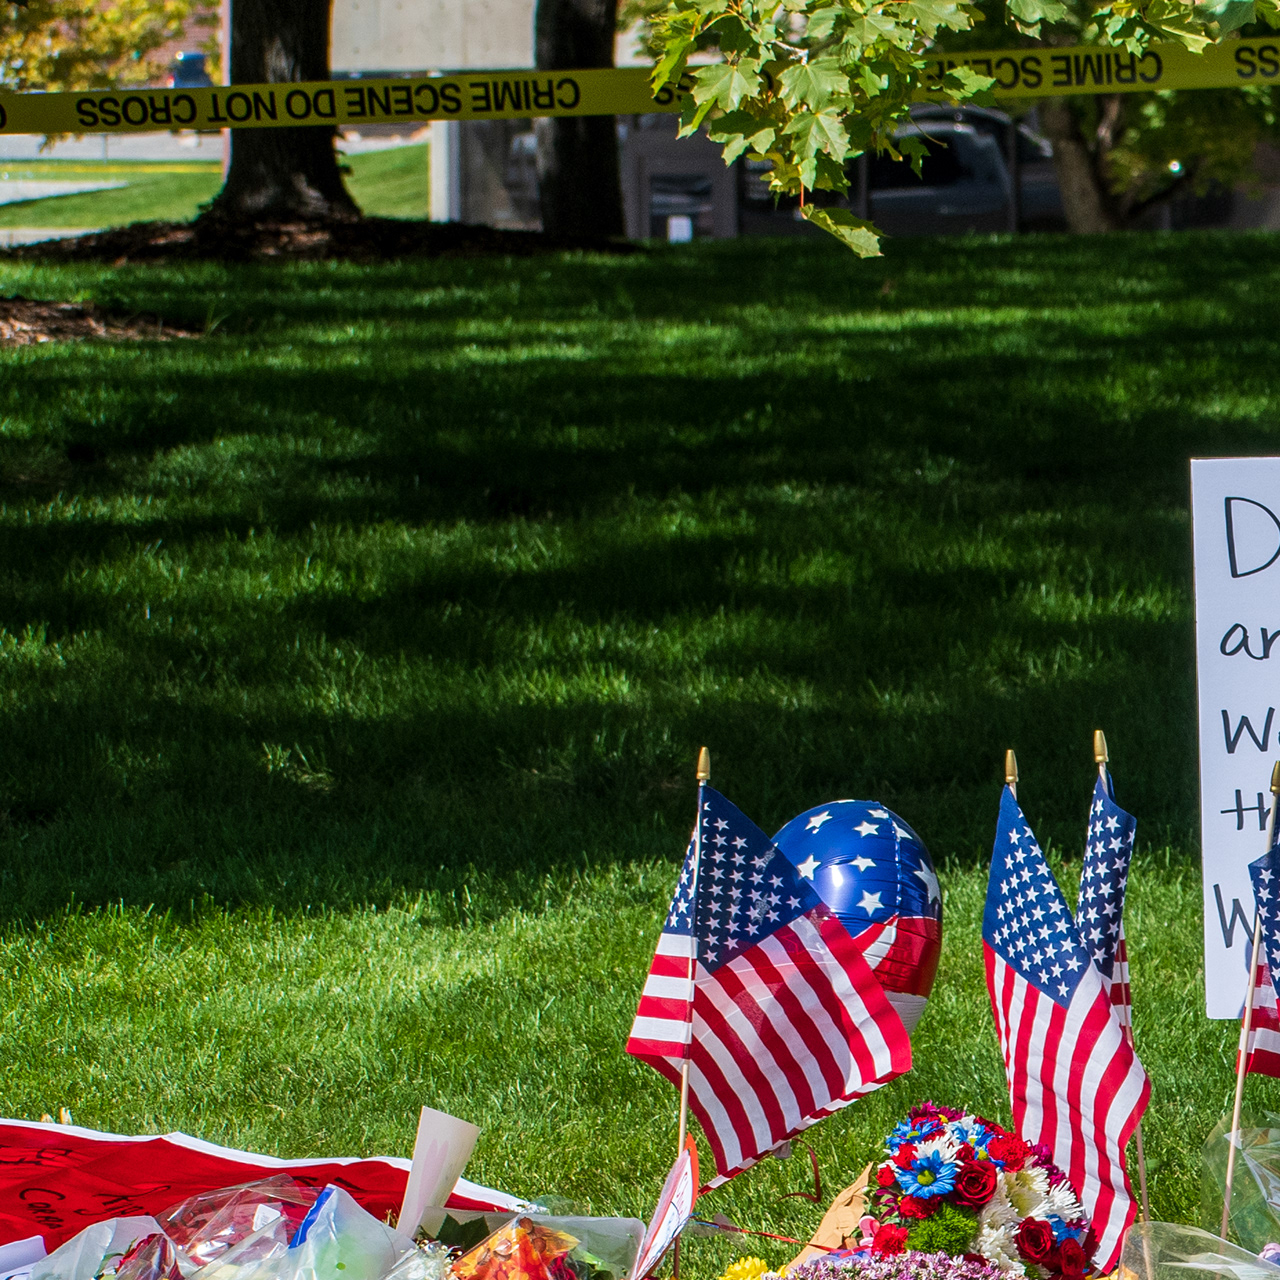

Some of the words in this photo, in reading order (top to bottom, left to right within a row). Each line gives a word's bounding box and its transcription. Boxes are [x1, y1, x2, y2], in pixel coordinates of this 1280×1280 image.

[1051, 51, 1163, 86] CRIME
[208, 91, 278, 122] NOT
[285, 88, 337, 119] DO
[344, 83, 462, 116] SCENE
[470, 78, 580, 111] CRIME
[76, 95, 197, 127] CROSS
